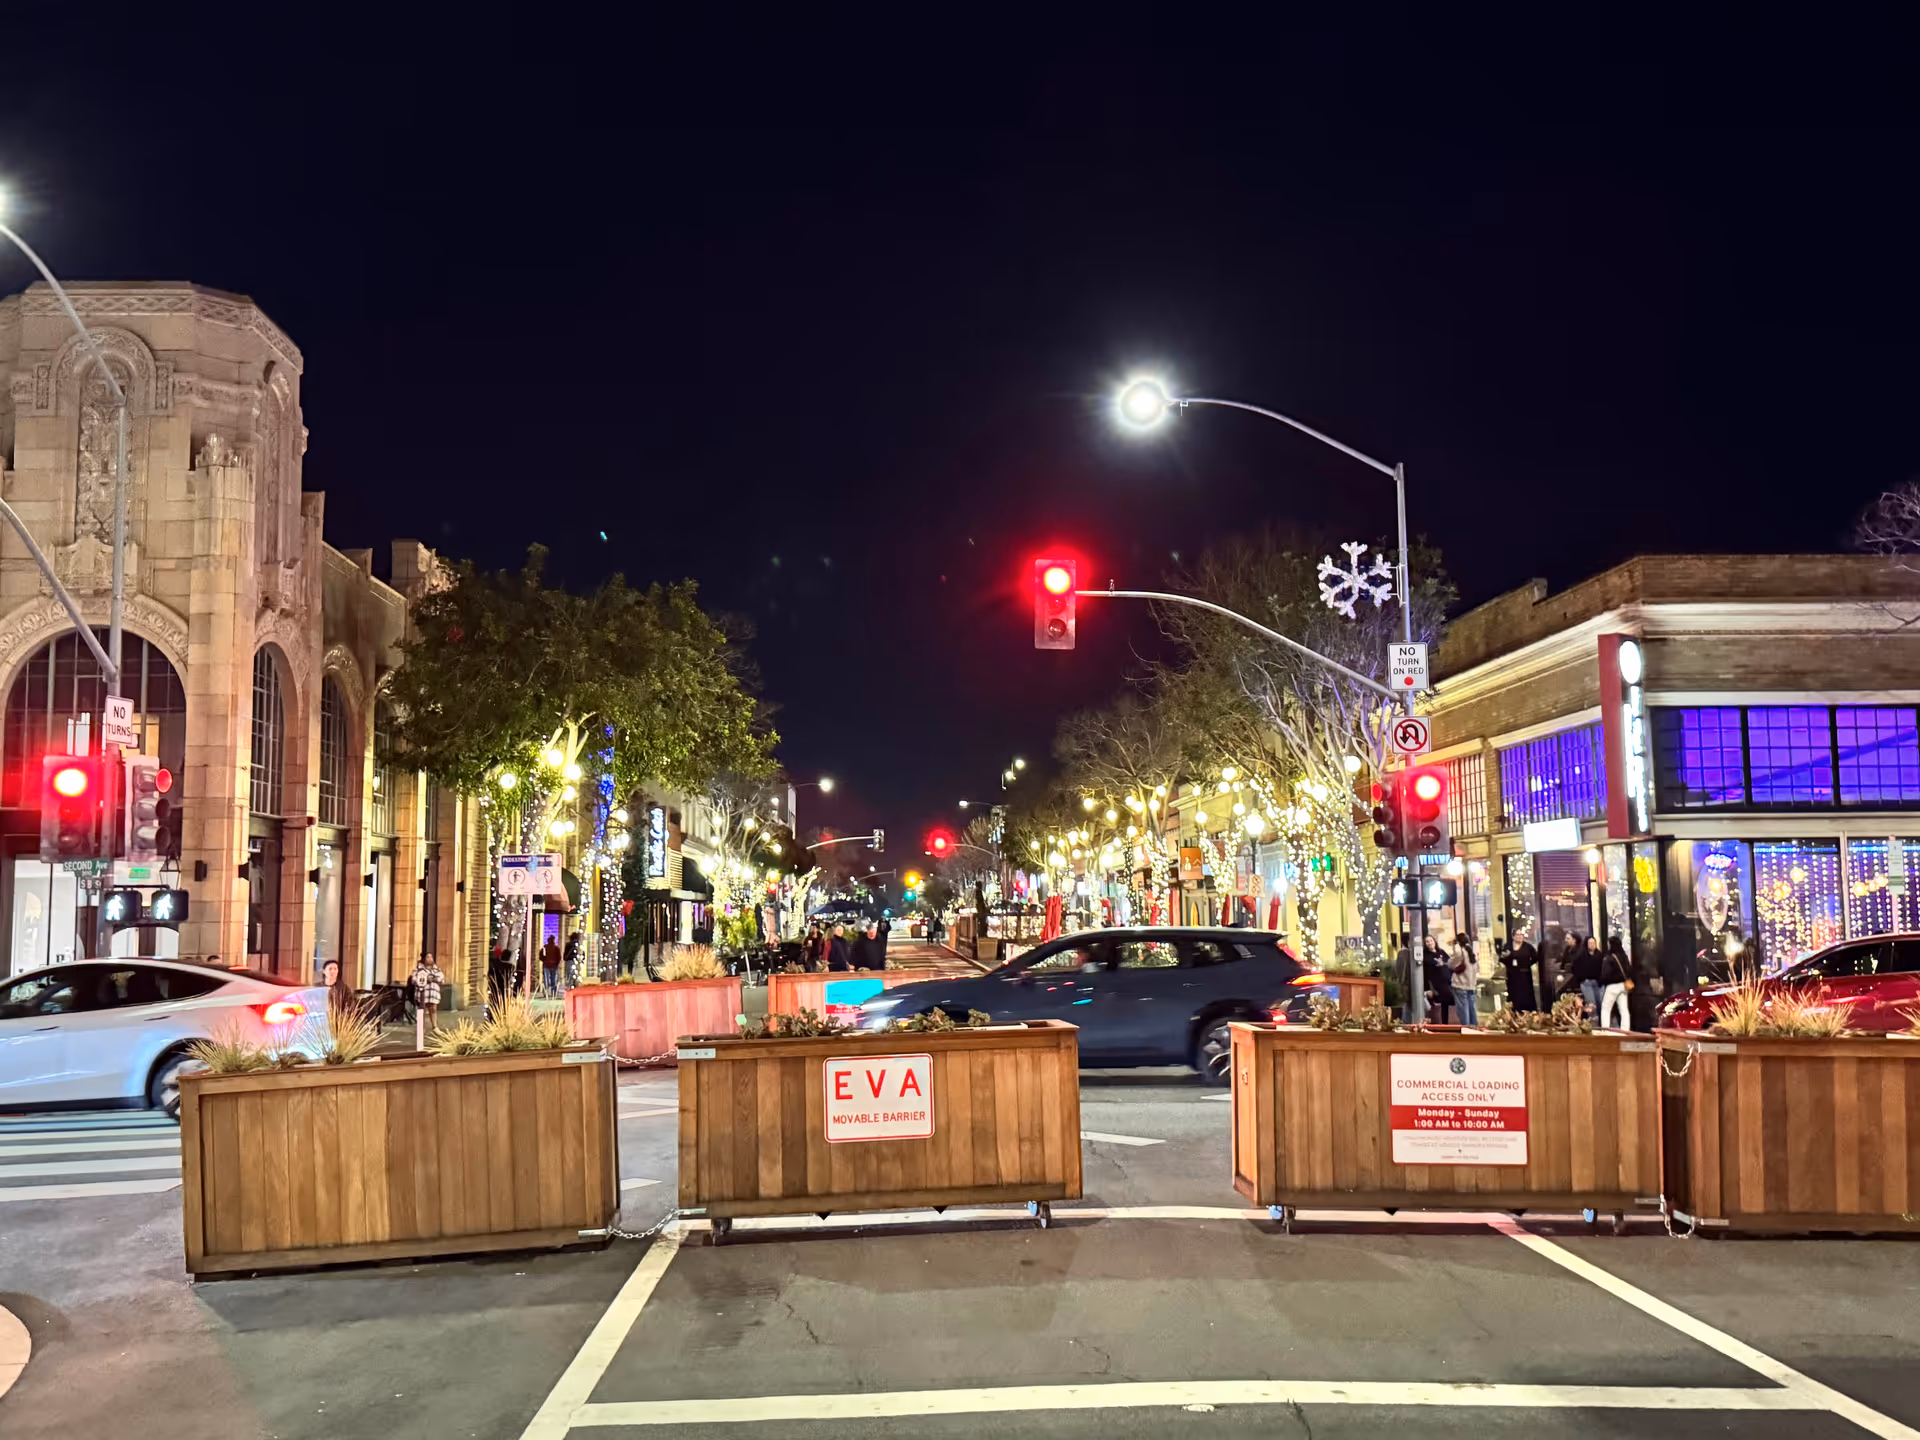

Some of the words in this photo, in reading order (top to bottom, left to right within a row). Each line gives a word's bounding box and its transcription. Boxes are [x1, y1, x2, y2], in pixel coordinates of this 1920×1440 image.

[1399, 647, 1416, 656] NO
[1408, 667, 1424, 675] RED
[113, 705, 126, 719] NO
[107, 723, 132, 737] TURNS
[64, 861, 93, 871] SECOND
[95, 860, 108, 869] Ave
[834, 1068, 922, 1100] EVA
[1396, 1080, 1469, 1089] COMMERCIAL
[1472, 1081, 1520, 1090] LOADING
[1421, 1092, 1464, 1101] ACCESS
[1467, 1093, 1496, 1102] ONLY
[832, 1113, 880, 1125] MOVABLE
[882, 1111, 926, 1123] BARRIER
[1418, 1108, 1455, 1118] Monday
[1464, 1109, 1500, 1119] Sunday
[1414, 1119, 1433, 1127] 1:00
[1452, 1120, 1461, 1128] to
